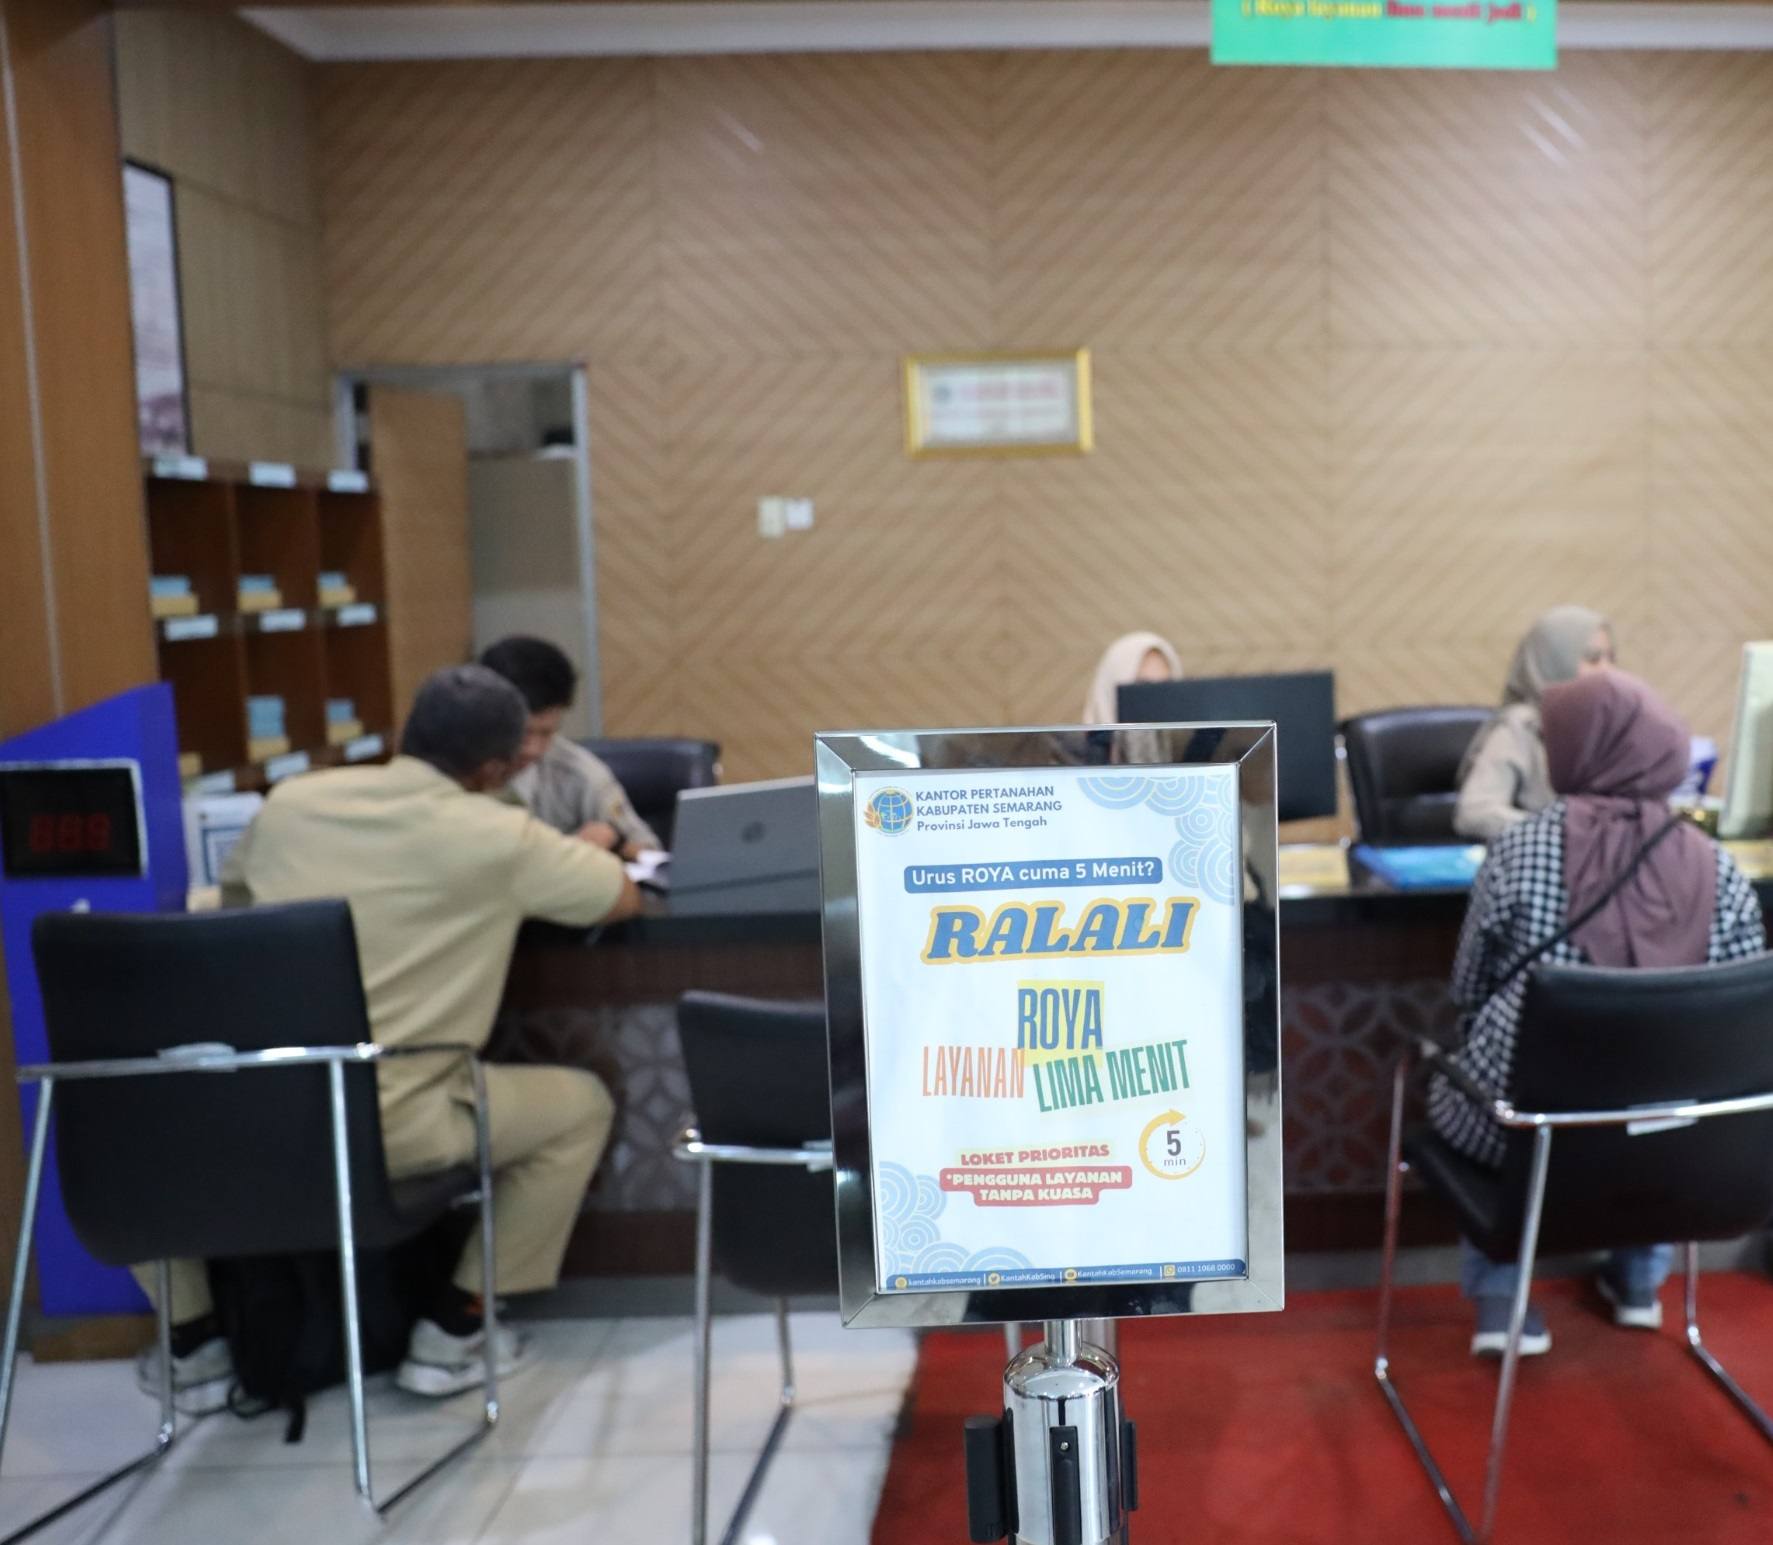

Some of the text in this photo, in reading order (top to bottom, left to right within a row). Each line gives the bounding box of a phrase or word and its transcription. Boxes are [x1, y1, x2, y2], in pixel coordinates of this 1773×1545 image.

[915, 786, 1055, 801] KANTOR PERTANAHAN
[916, 800, 1062, 816] KABUPATEN SEMARANG
[917, 816, 1047, 831] Provinsi Jawa Tengah
[911, 860, 1155, 886] Urus ROYA cuma 5 Menit?
[924, 899, 1198, 961] RALALI
[1017, 987, 1103, 1050] ROYA
[922, 1045, 1025, 1098] LAYANAN
[1032, 1039, 1190, 1113] LIMA MENIT
[1166, 1130, 1182, 1157] 5
[961, 1144, 1110, 1166] LOKET PRIORITAS
[1163, 1157, 1187, 1167] min
[1045, 1171, 1123, 1184] LAYANAN
[979, 1187, 1093, 1201] TANPA KUASA
